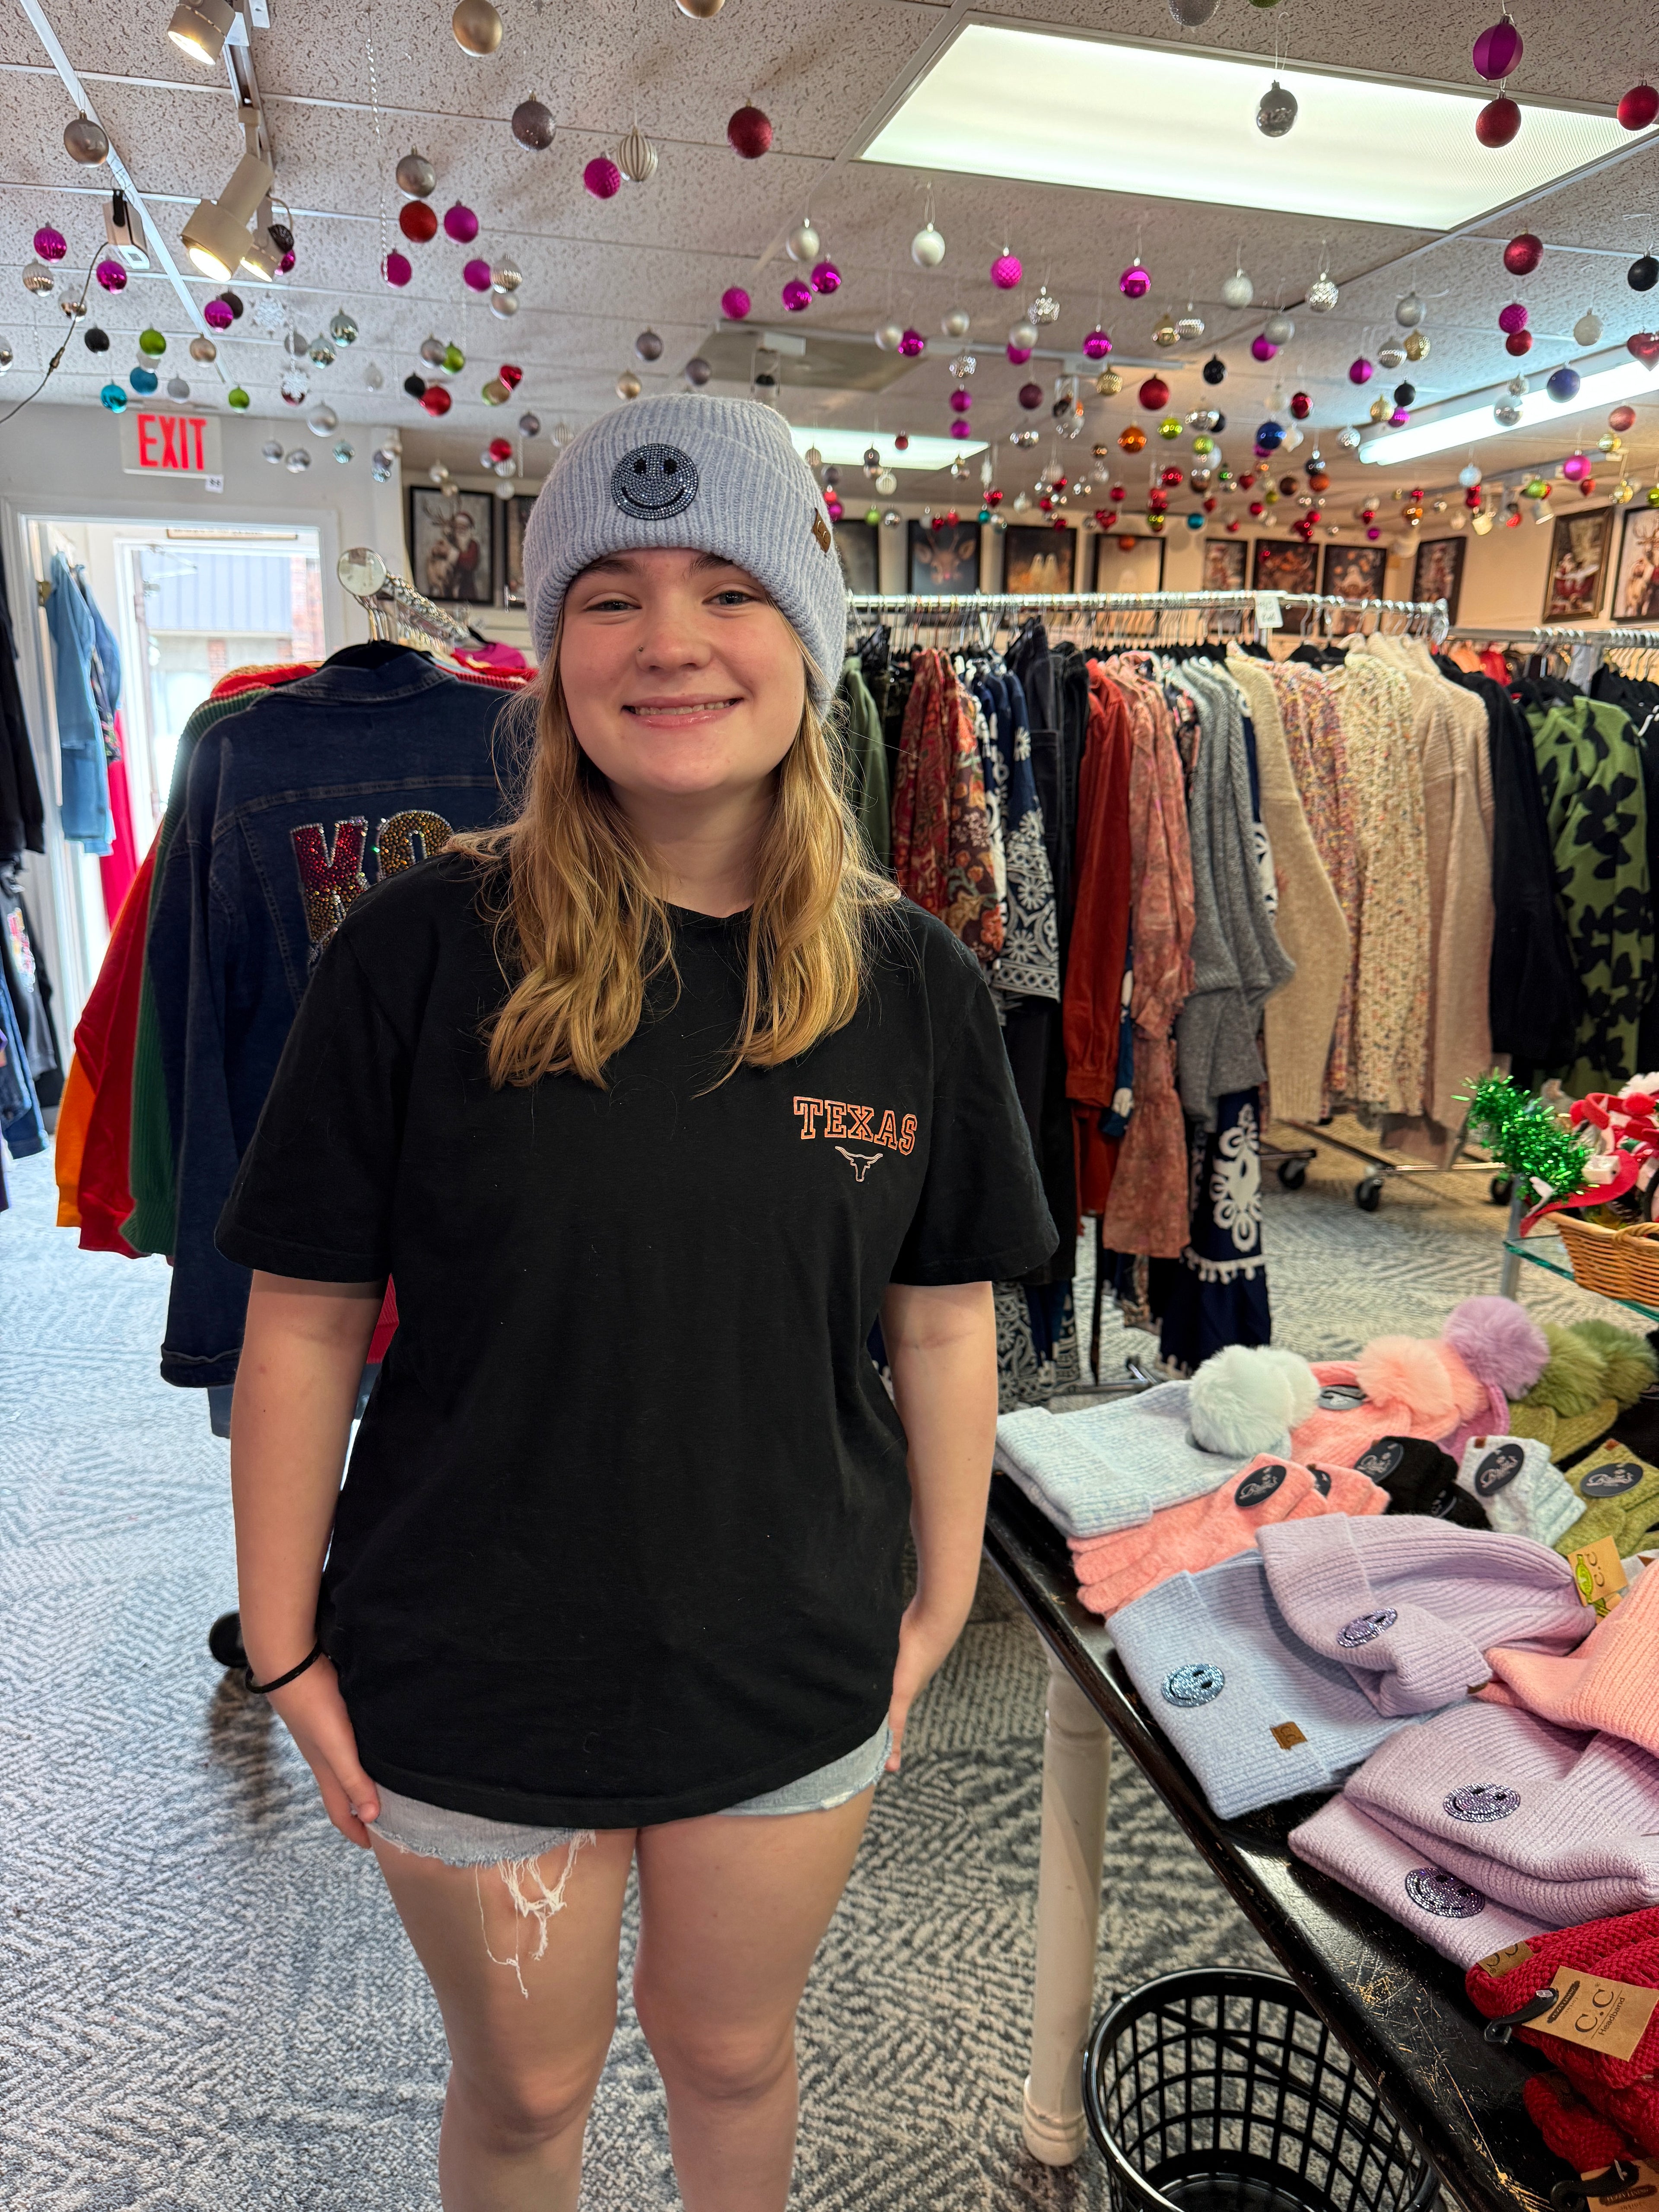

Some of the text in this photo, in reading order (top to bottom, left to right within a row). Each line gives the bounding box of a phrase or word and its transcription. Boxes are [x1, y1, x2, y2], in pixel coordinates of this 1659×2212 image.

[137, 413, 207, 470] EXIT
[793, 1096, 918, 1156] TEXAS
[1598, 1996, 1625, 2035] Headband
